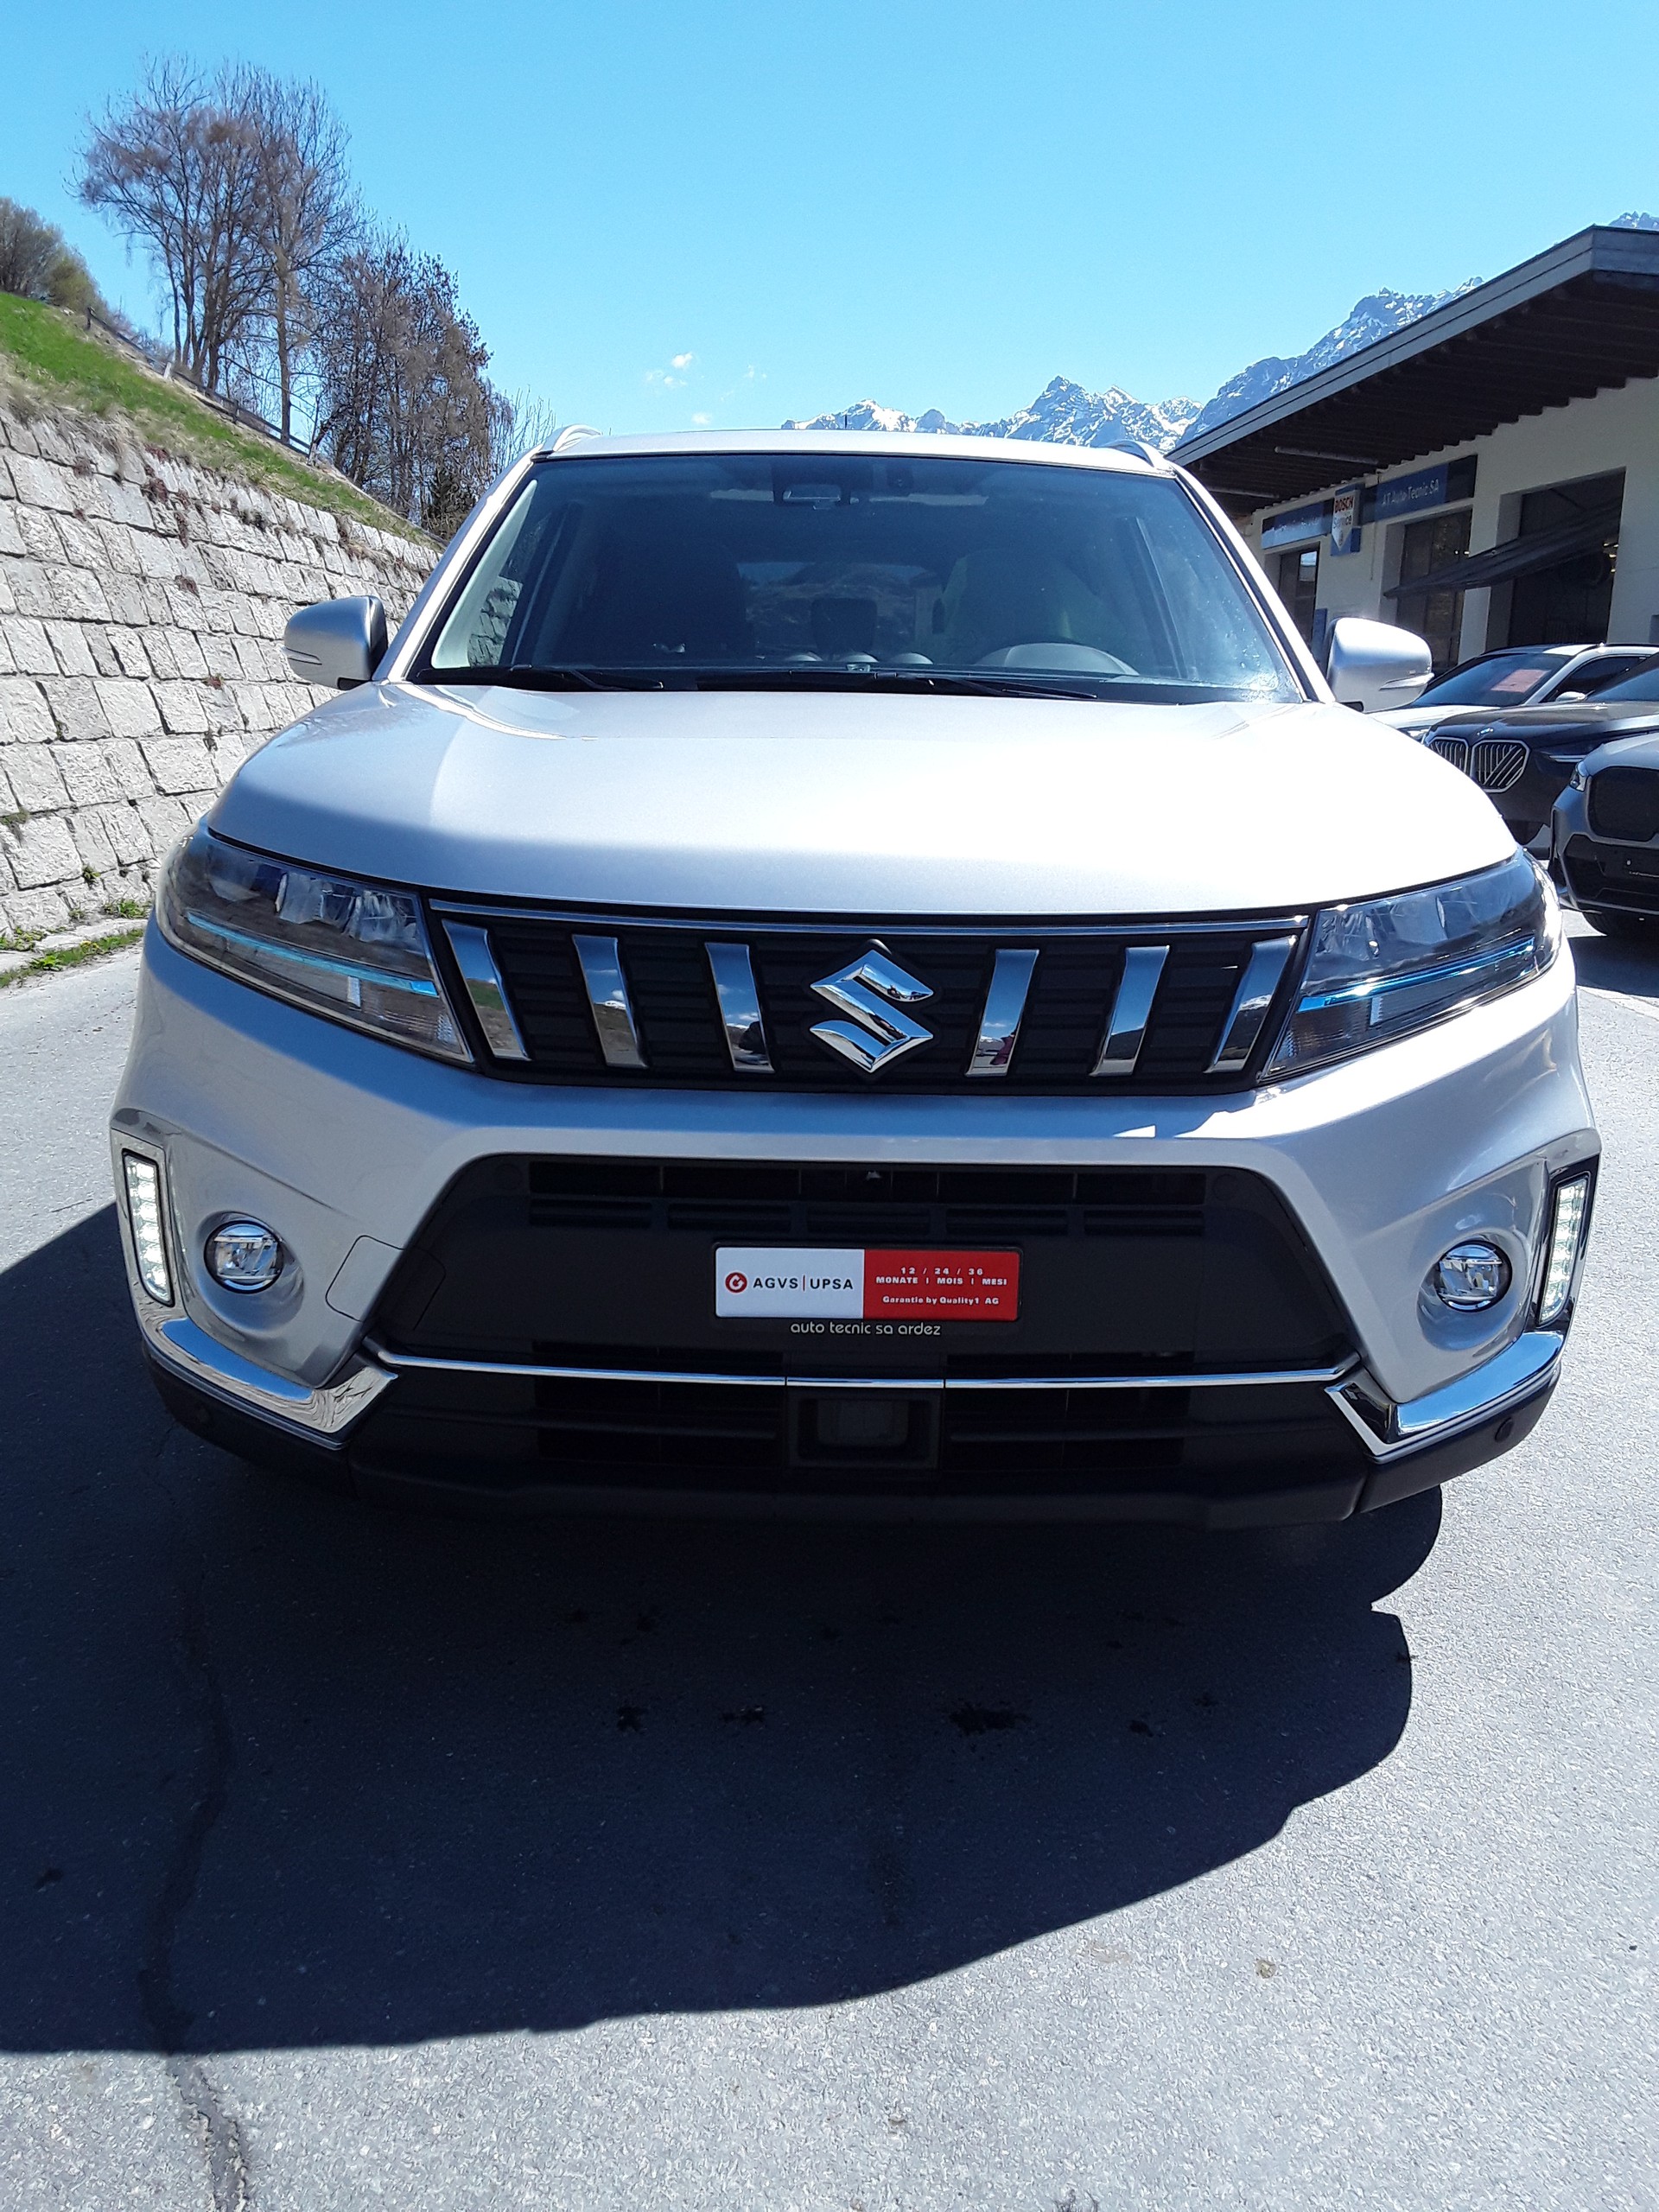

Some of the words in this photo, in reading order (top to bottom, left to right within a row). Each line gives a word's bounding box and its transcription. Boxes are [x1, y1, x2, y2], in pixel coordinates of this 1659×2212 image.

[1334, 495, 1354, 513] BOSCH
[753, 1277, 798, 1289] AGVS
[810, 1278, 854, 1290] UPSA
[925, 1296, 938, 1306] by
[939, 1296, 979, 1306] Quality1
[791, 1323, 825, 1334] auto
[830, 1323, 871, 1335] tecnic
[876, 1324, 893, 1335] sa
[898, 1323, 941, 1336] ardez
